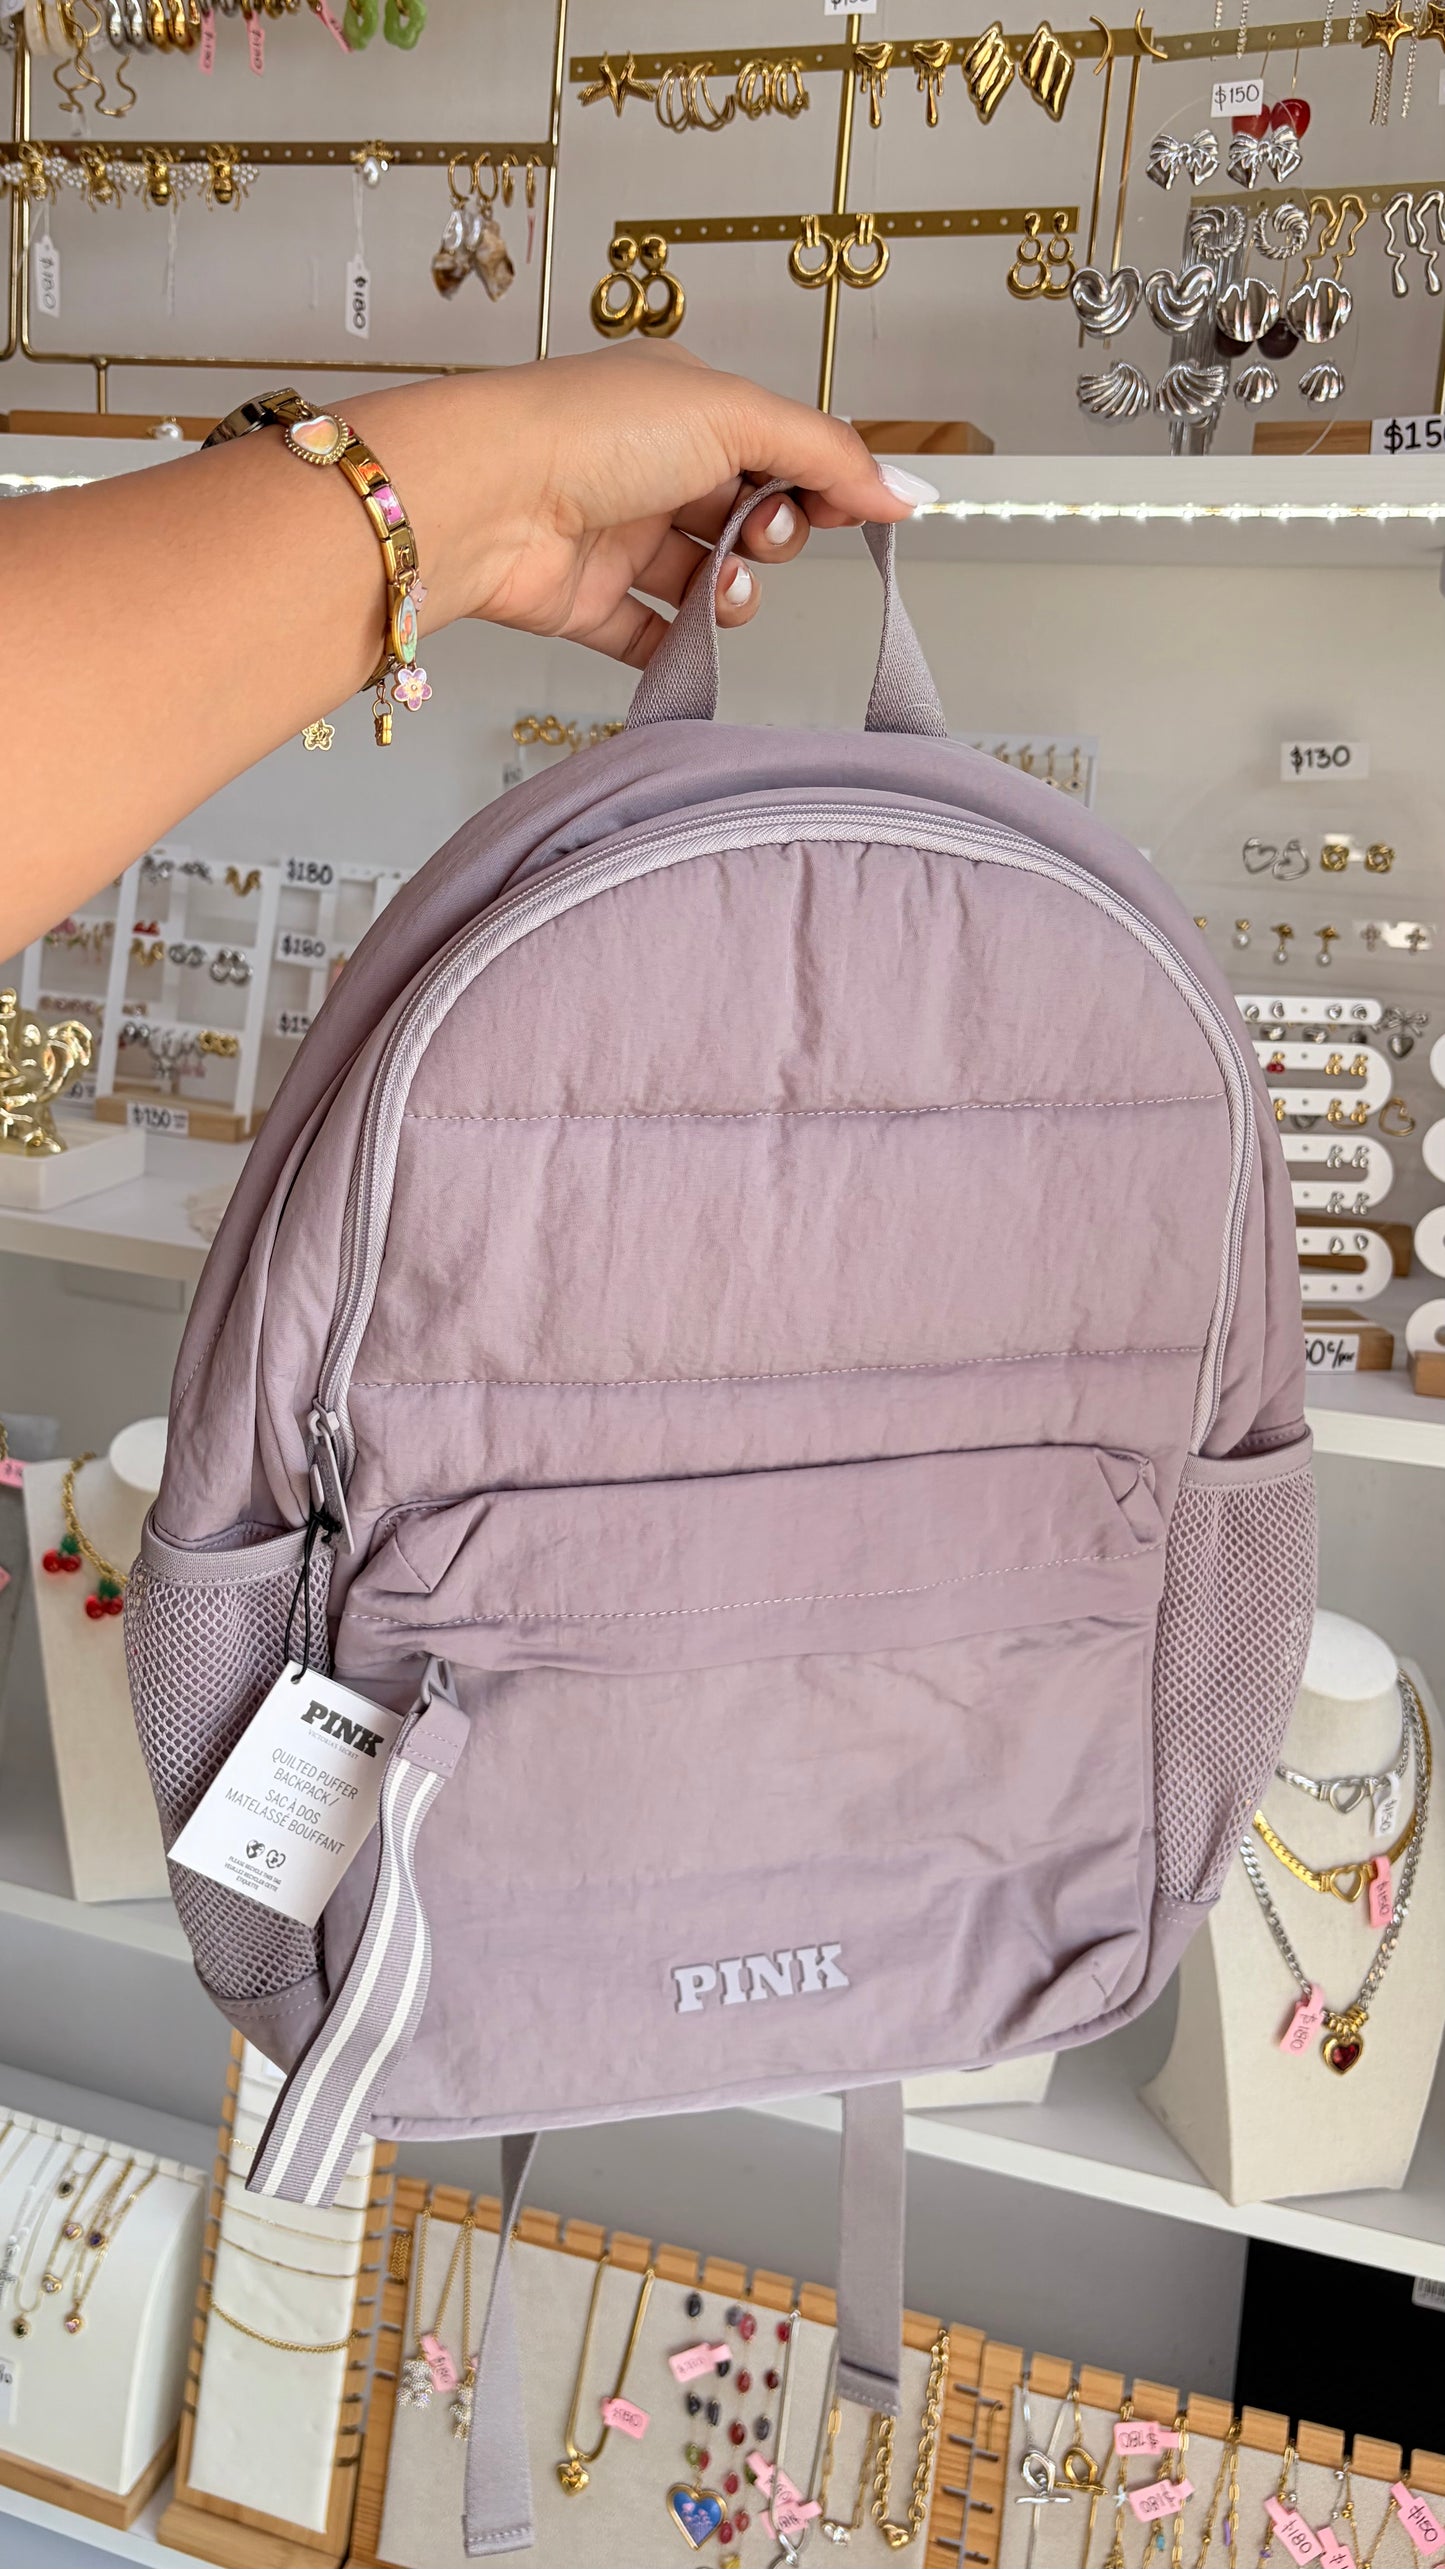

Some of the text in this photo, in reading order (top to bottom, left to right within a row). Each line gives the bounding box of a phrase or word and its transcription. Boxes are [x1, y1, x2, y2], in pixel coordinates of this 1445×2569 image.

[1214, 85, 1260, 112] $150
[40, 257, 57, 310] $180
[352, 276, 367, 330] $180
[1384, 419, 1445, 455] $15
[1290, 745, 1351, 775] $130
[287, 857, 333, 885] $180
[301, 1700, 384, 1758] PINK
[272, 1748, 359, 1800] QUILTED PUFFER
[273, 1767, 331, 1805] BACKPACK
[225, 1787, 346, 1855] MATELASSÉ BOUFFANT
[265, 1789, 321, 1825] SAC À DOS
[671, 1942, 850, 2013] PINK
[1290, 2012, 1318, 2050] $180
[1139, 2484, 1176, 2513] $180
[1281, 2519, 1313, 2554] $180
[1407, 2505, 1438, 2542] $150
